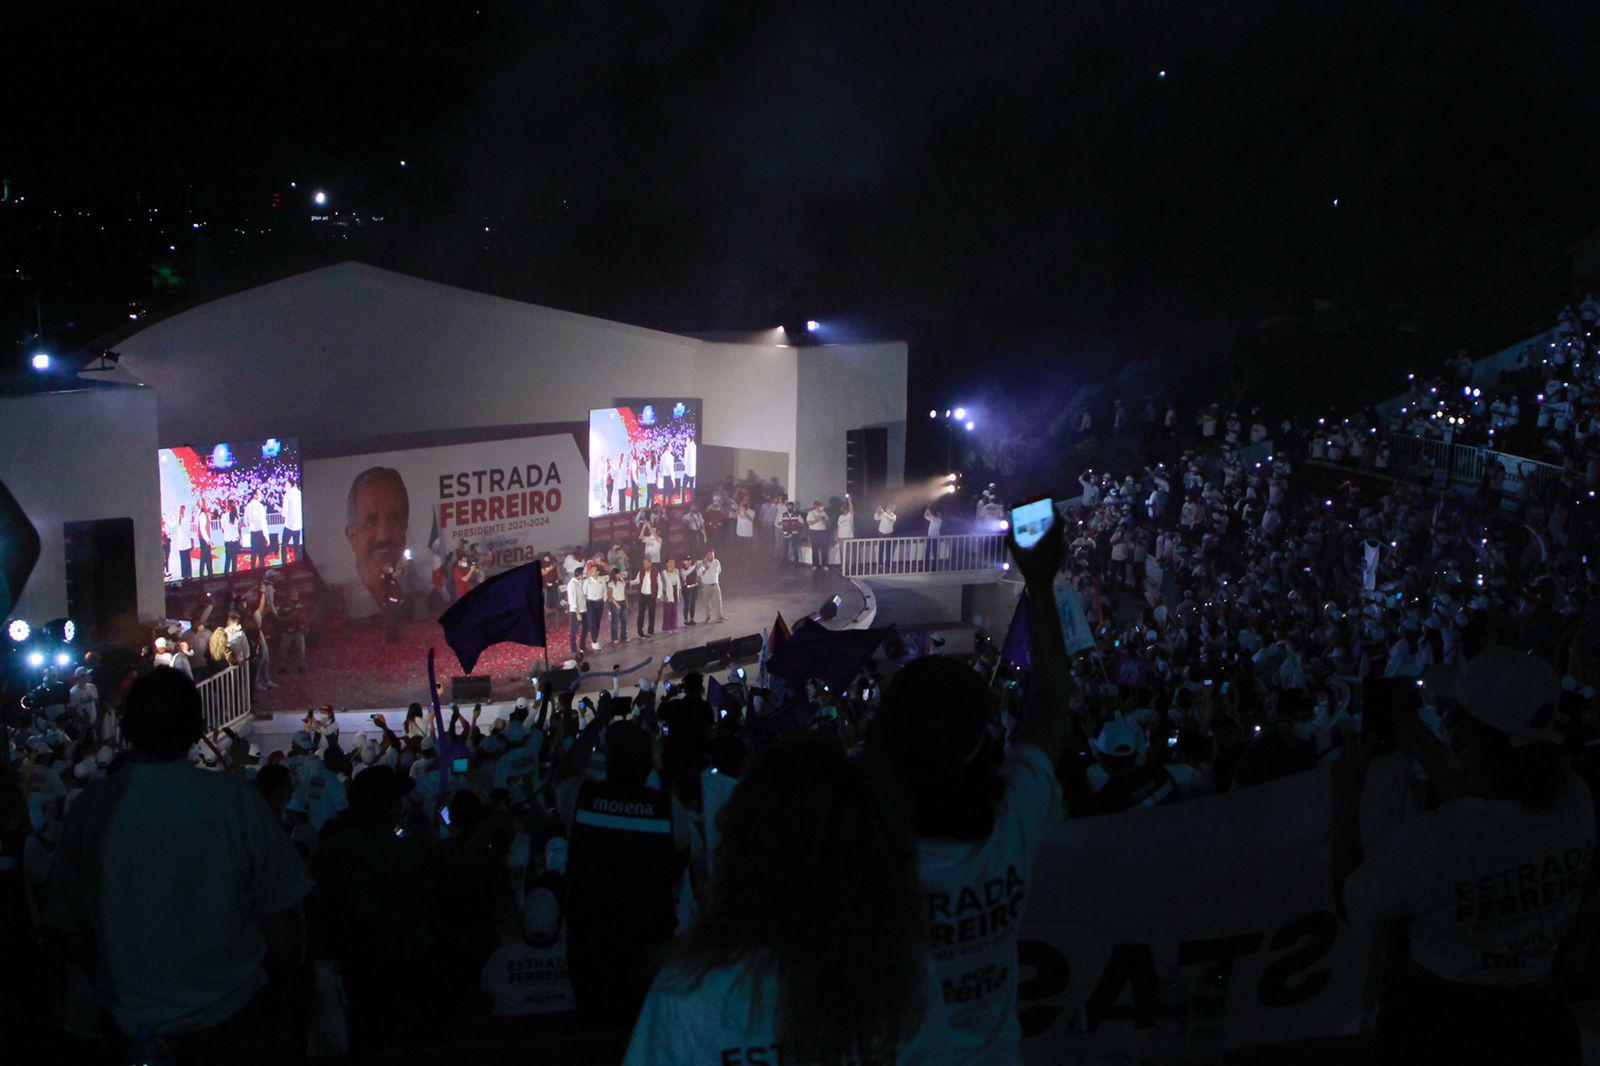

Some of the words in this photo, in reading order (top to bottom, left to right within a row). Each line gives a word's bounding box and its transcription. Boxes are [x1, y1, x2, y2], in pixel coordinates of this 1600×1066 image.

[439, 462, 561, 499] ESTRADA
[440, 488, 562, 528] FERREIRO
[452, 523, 505, 539] PRESIDENTE
[508, 517, 549, 530] 2021-2024
[592, 797, 654, 817] morena
